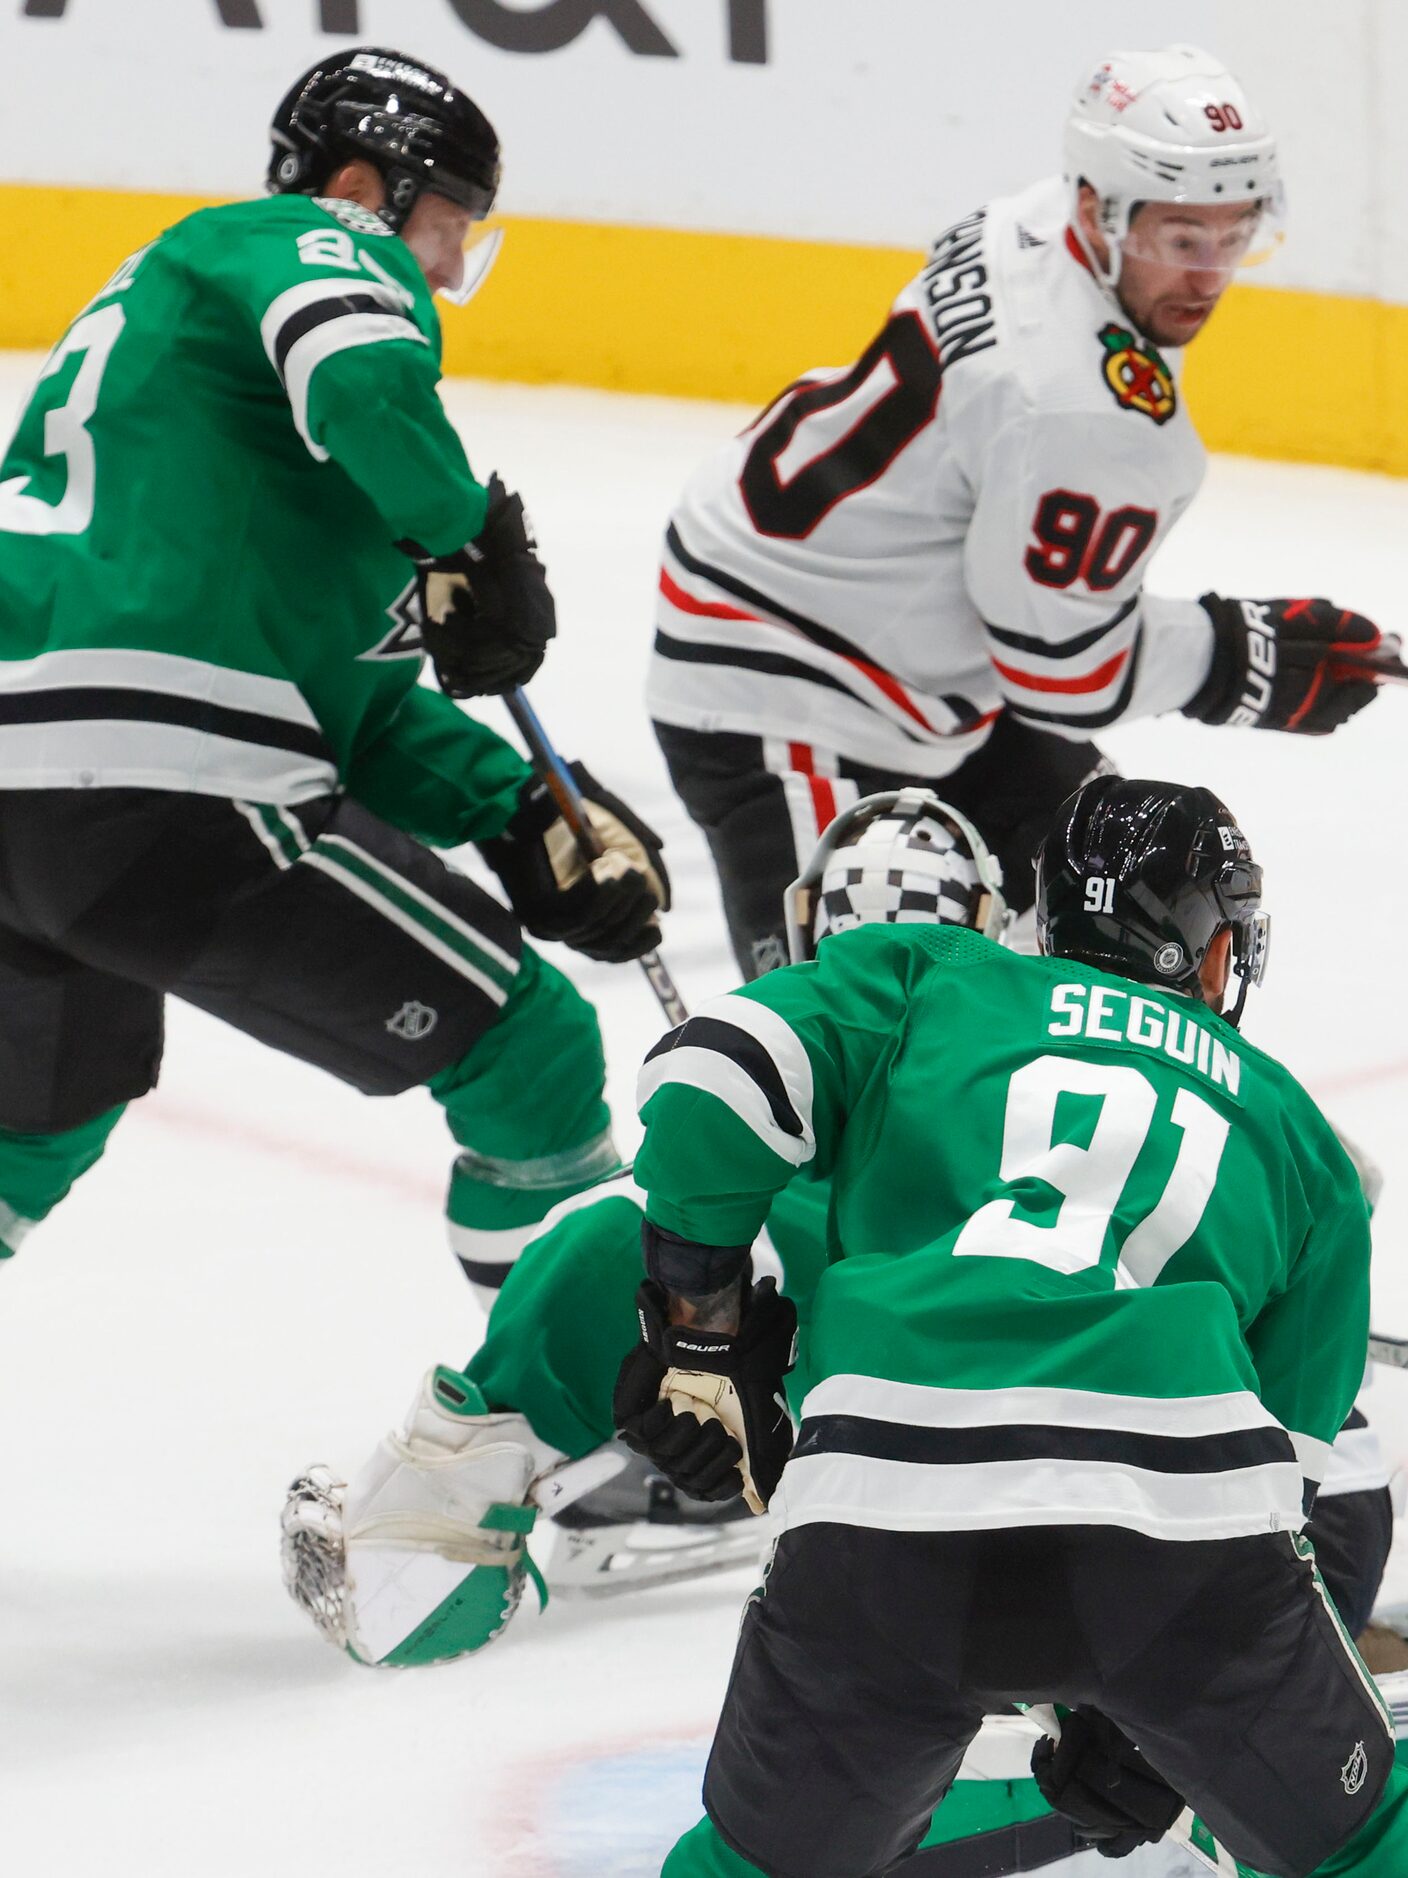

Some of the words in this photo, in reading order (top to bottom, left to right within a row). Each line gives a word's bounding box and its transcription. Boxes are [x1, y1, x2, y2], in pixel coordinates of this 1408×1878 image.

[1204, 103, 1243, 133] 90
[1023, 487, 1159, 592] 90
[1224, 600, 1277, 727] AUER
[1083, 875, 1117, 914] 91
[1047, 983, 1241, 1097] SEGUIN
[953, 1054, 1233, 1291] 91
[675, 1340, 731, 1353] BAUER
